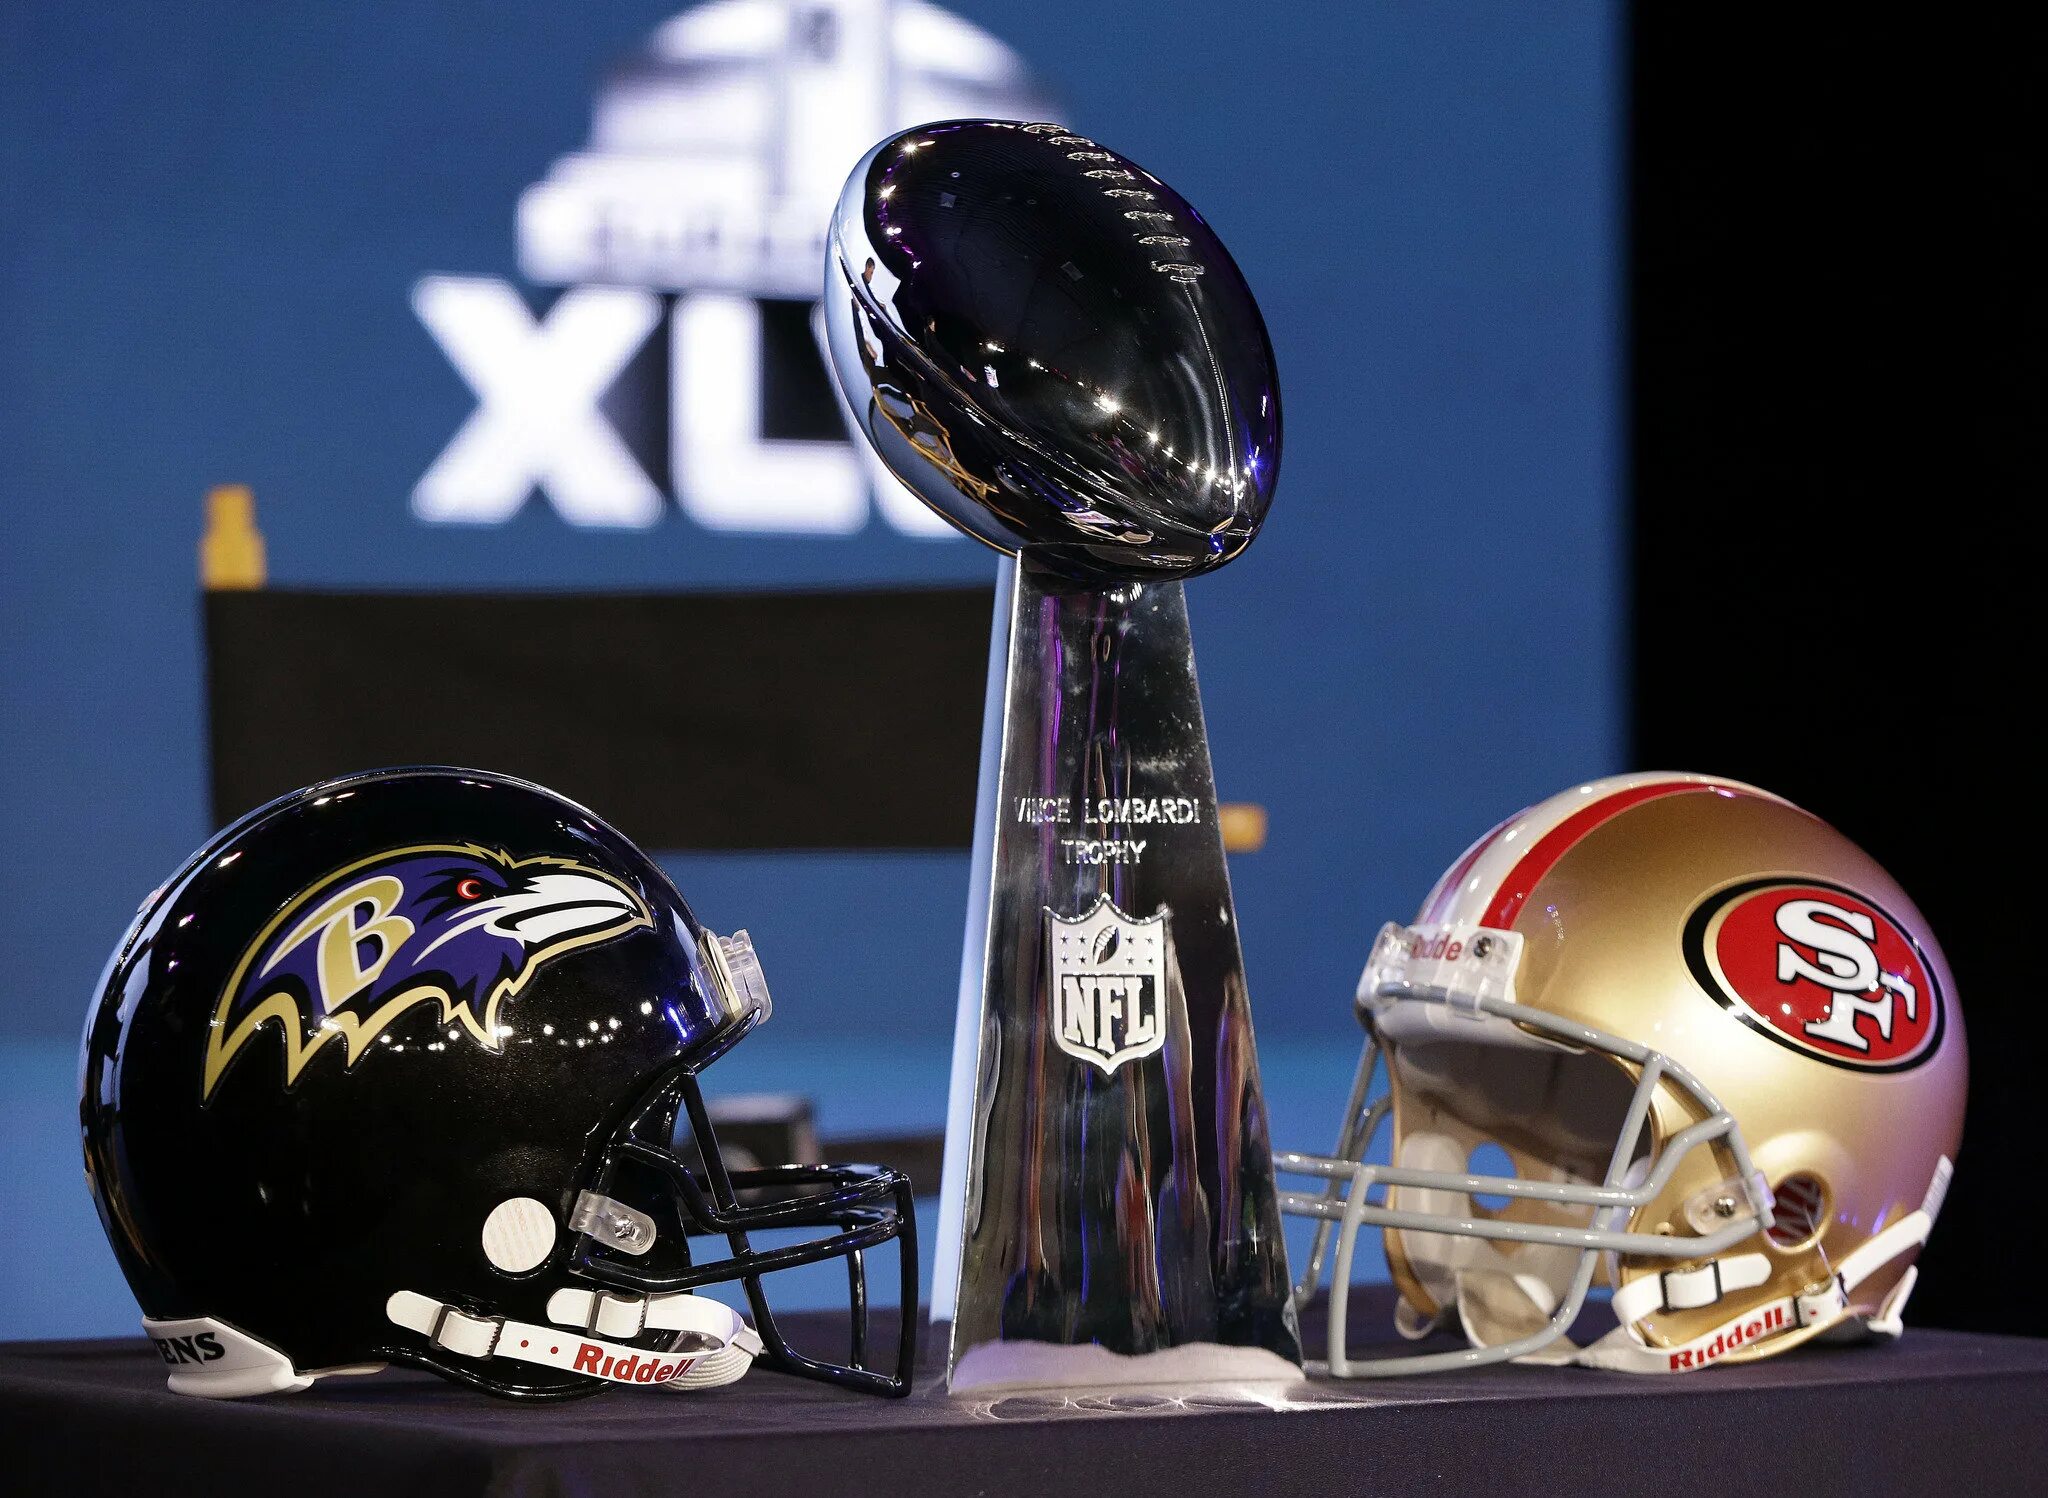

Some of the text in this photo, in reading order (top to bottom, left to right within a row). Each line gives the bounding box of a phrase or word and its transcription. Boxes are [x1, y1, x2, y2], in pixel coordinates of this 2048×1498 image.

[1014, 796, 1201, 825] VINCE LOMBARDI
[1061, 838, 1147, 865] TROPHY
[1062, 976, 1155, 1055] NFL
[1669, 1306, 1784, 1371] Riddell
